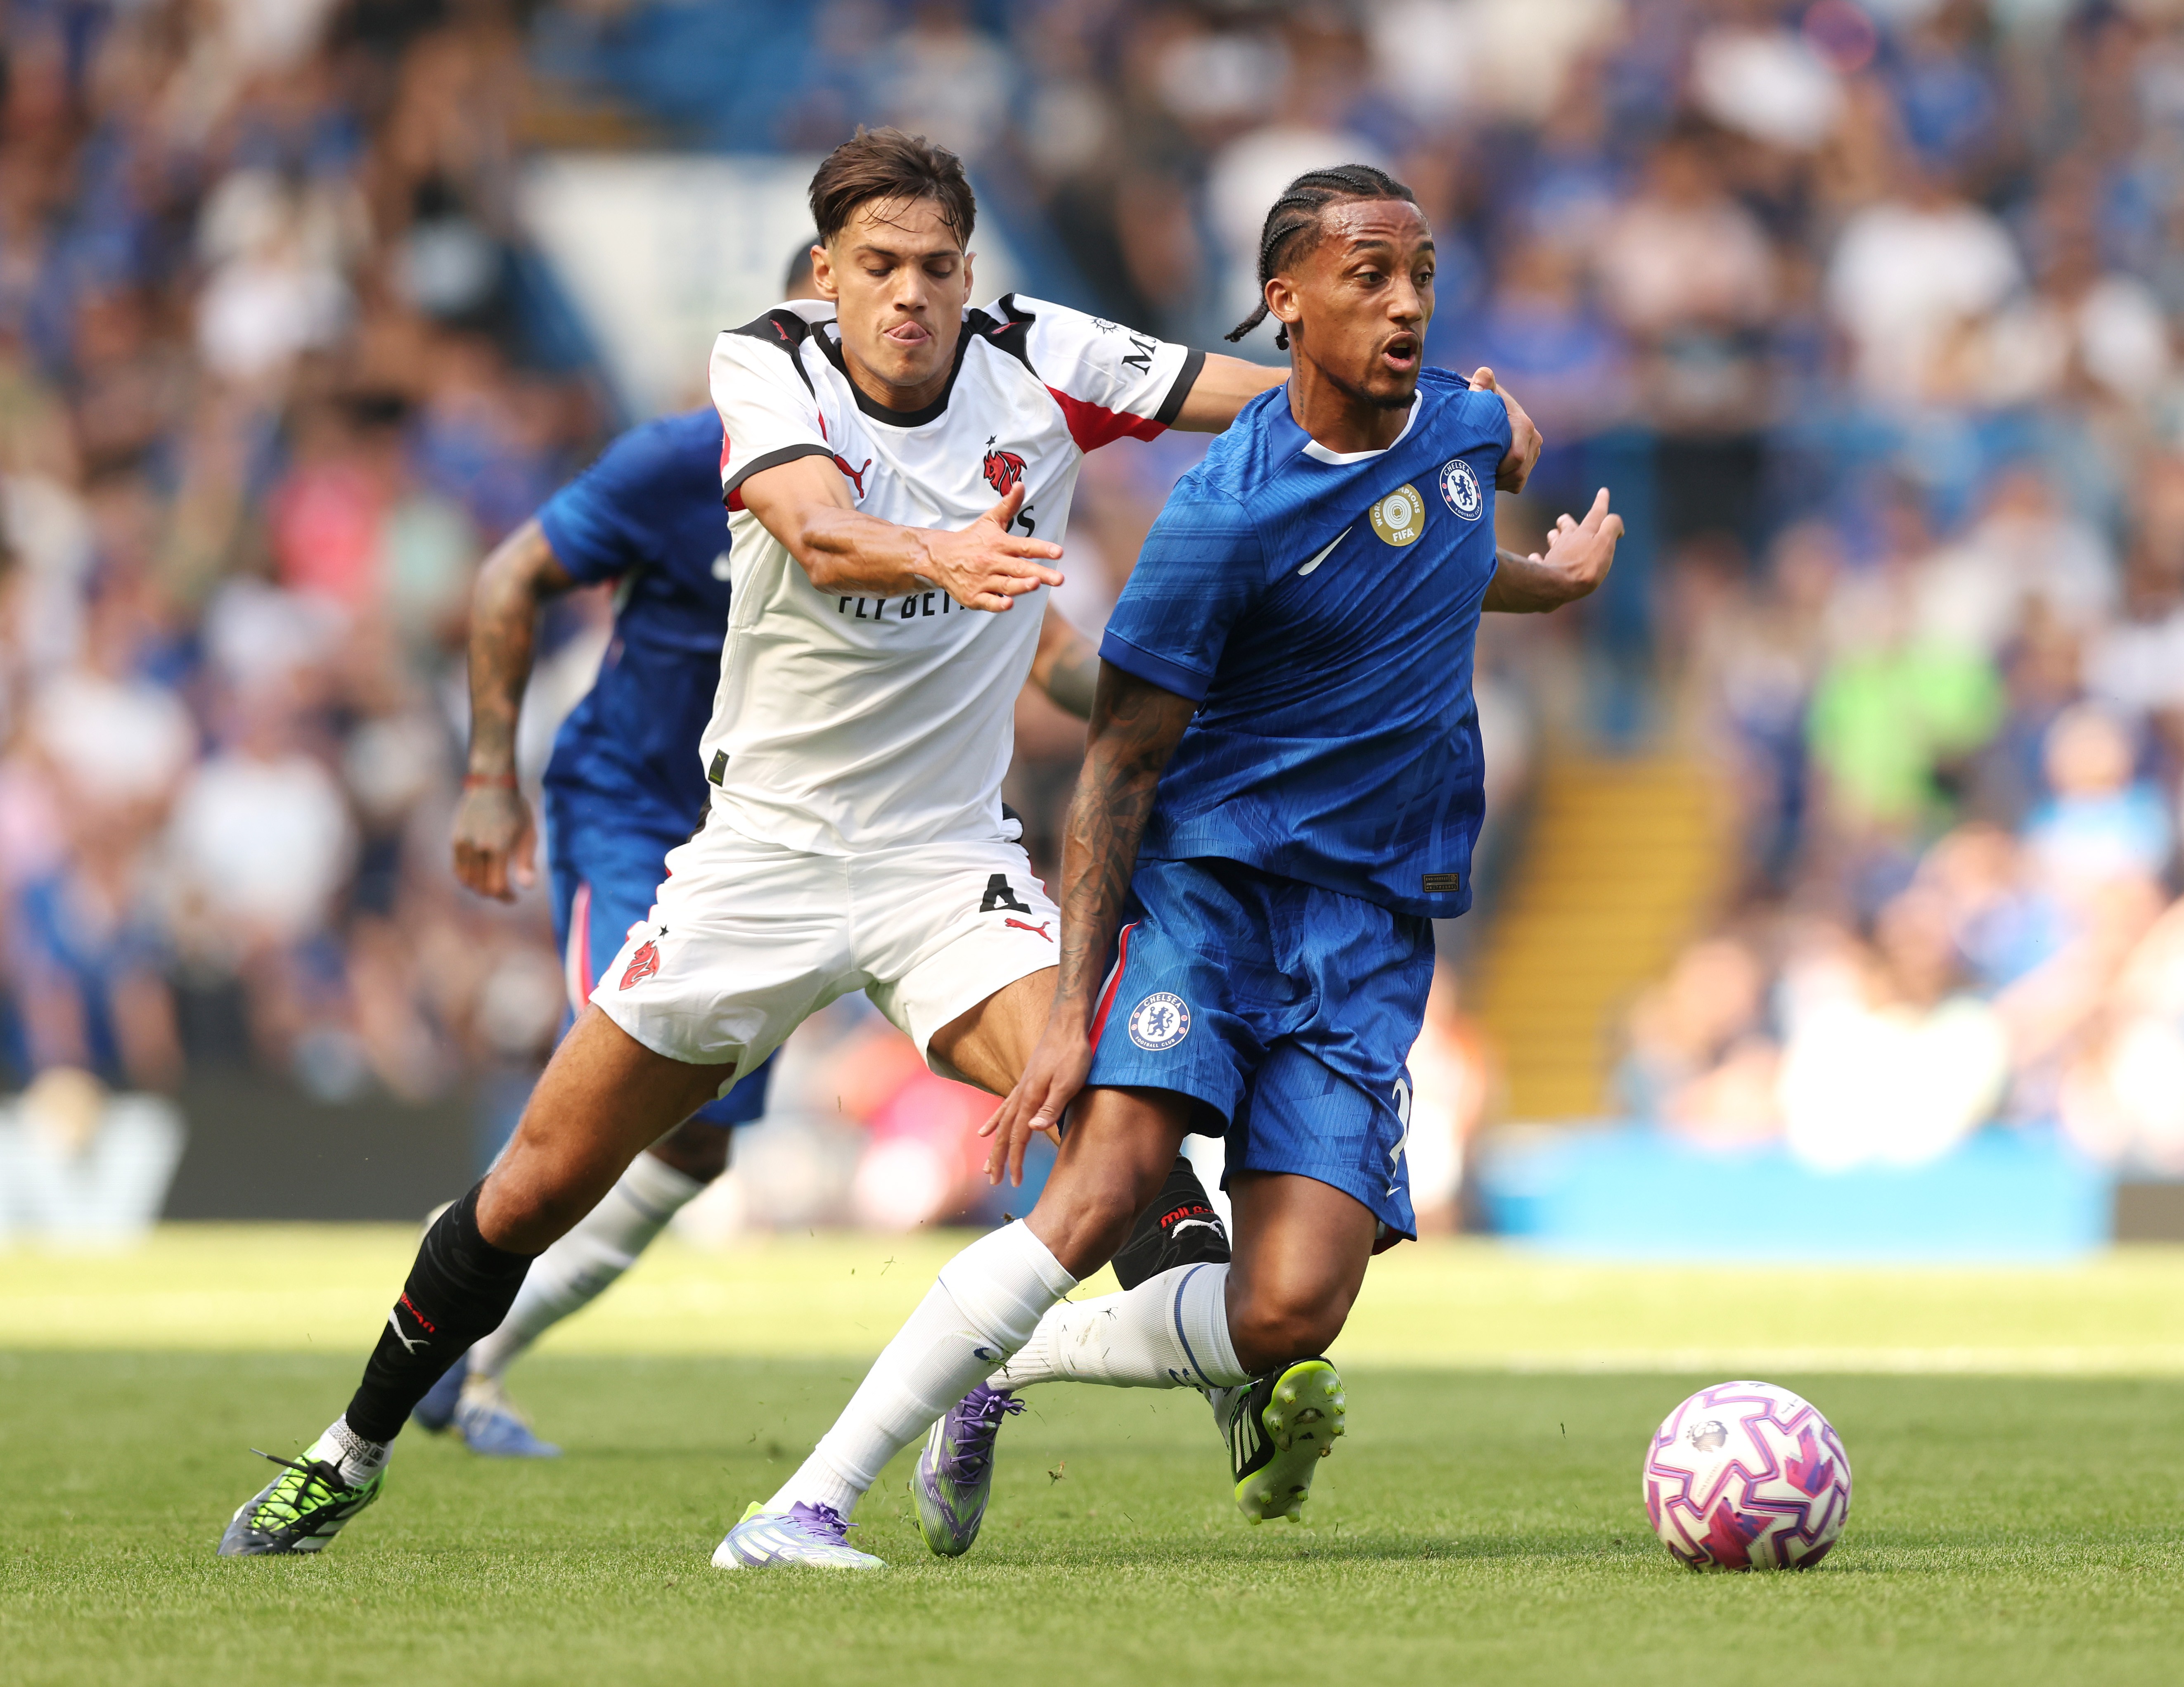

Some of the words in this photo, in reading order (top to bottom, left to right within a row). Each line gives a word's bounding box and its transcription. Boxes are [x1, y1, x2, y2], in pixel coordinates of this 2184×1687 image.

[1444, 462, 1470, 476] CHELSEA
[1455, 507, 1475, 517] FOOTBALL
[1392, 527, 1414, 542] FIFA
[1144, 994, 1182, 1009] CHELSEA
[1135, 1036, 1159, 1048] FOOTBALL
[1161, 1038, 1175, 1047] CLUB
[777, 1547, 860, 1561] F50
